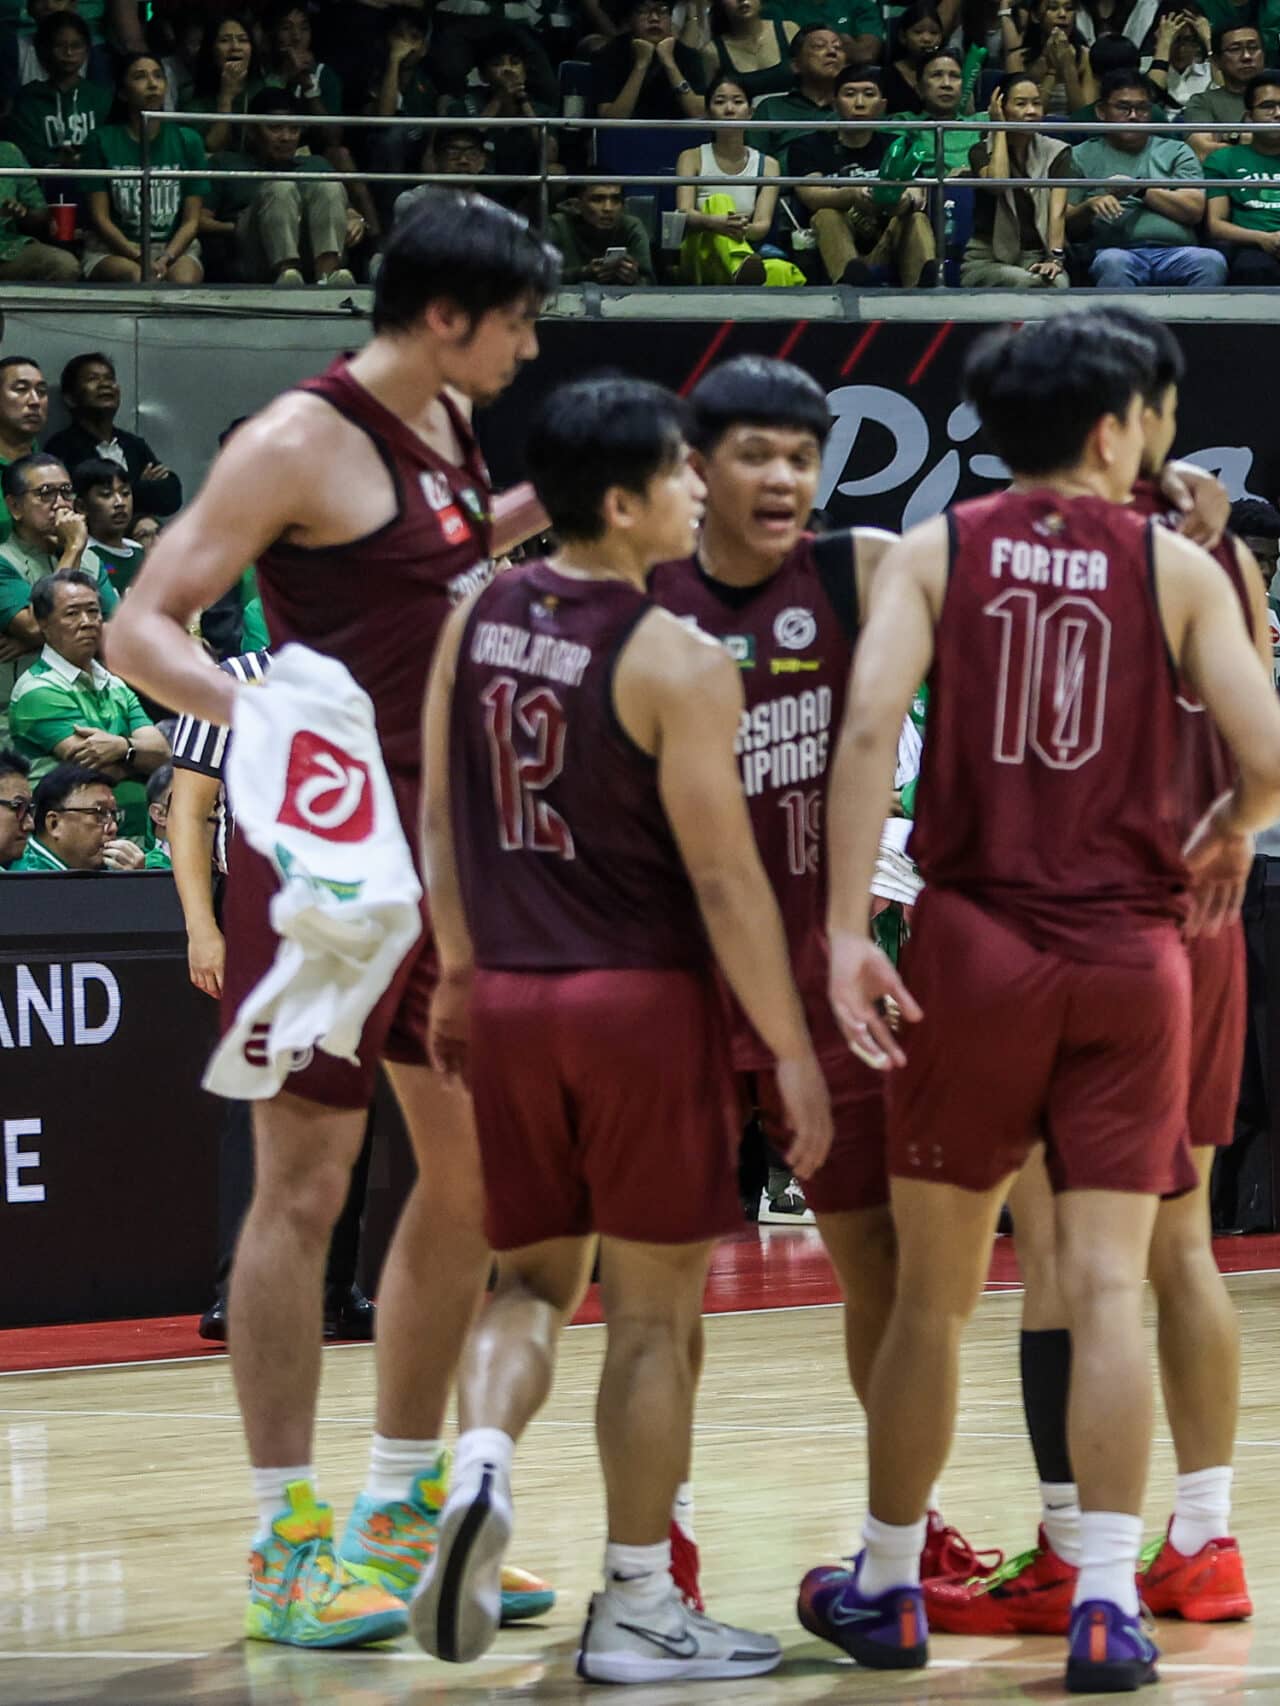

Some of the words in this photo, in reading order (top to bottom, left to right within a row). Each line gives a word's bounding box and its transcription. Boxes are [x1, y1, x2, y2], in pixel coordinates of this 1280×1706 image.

[816, 384, 1269, 535] Pia
[990, 537, 1109, 591] FORTEA
[982, 588, 1112, 770] 10
[483, 676, 575, 861] 12
[3, 1118, 47, 1204] E
